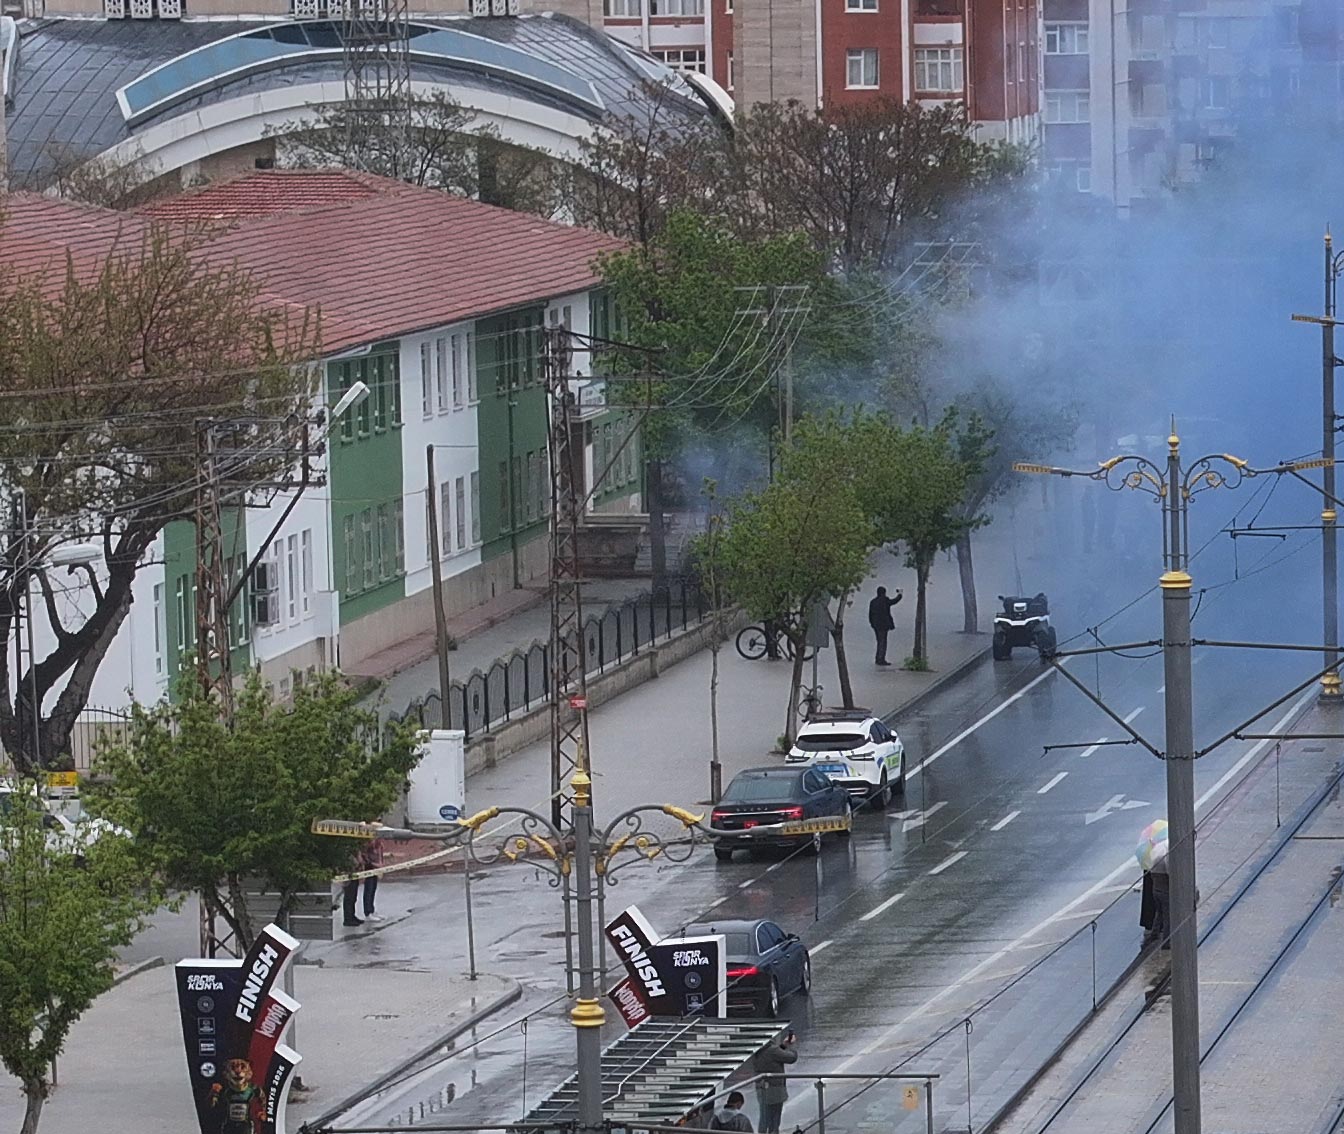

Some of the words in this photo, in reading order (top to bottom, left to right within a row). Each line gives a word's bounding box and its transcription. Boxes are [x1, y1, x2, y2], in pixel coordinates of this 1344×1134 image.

[611, 924, 666, 997] FINISH
[188, 981, 223, 991] KONYA
[235, 943, 279, 1023] FINISH
[272, 1064, 285, 1087] 2026
[267, 1089, 279, 1116] MAYIS
